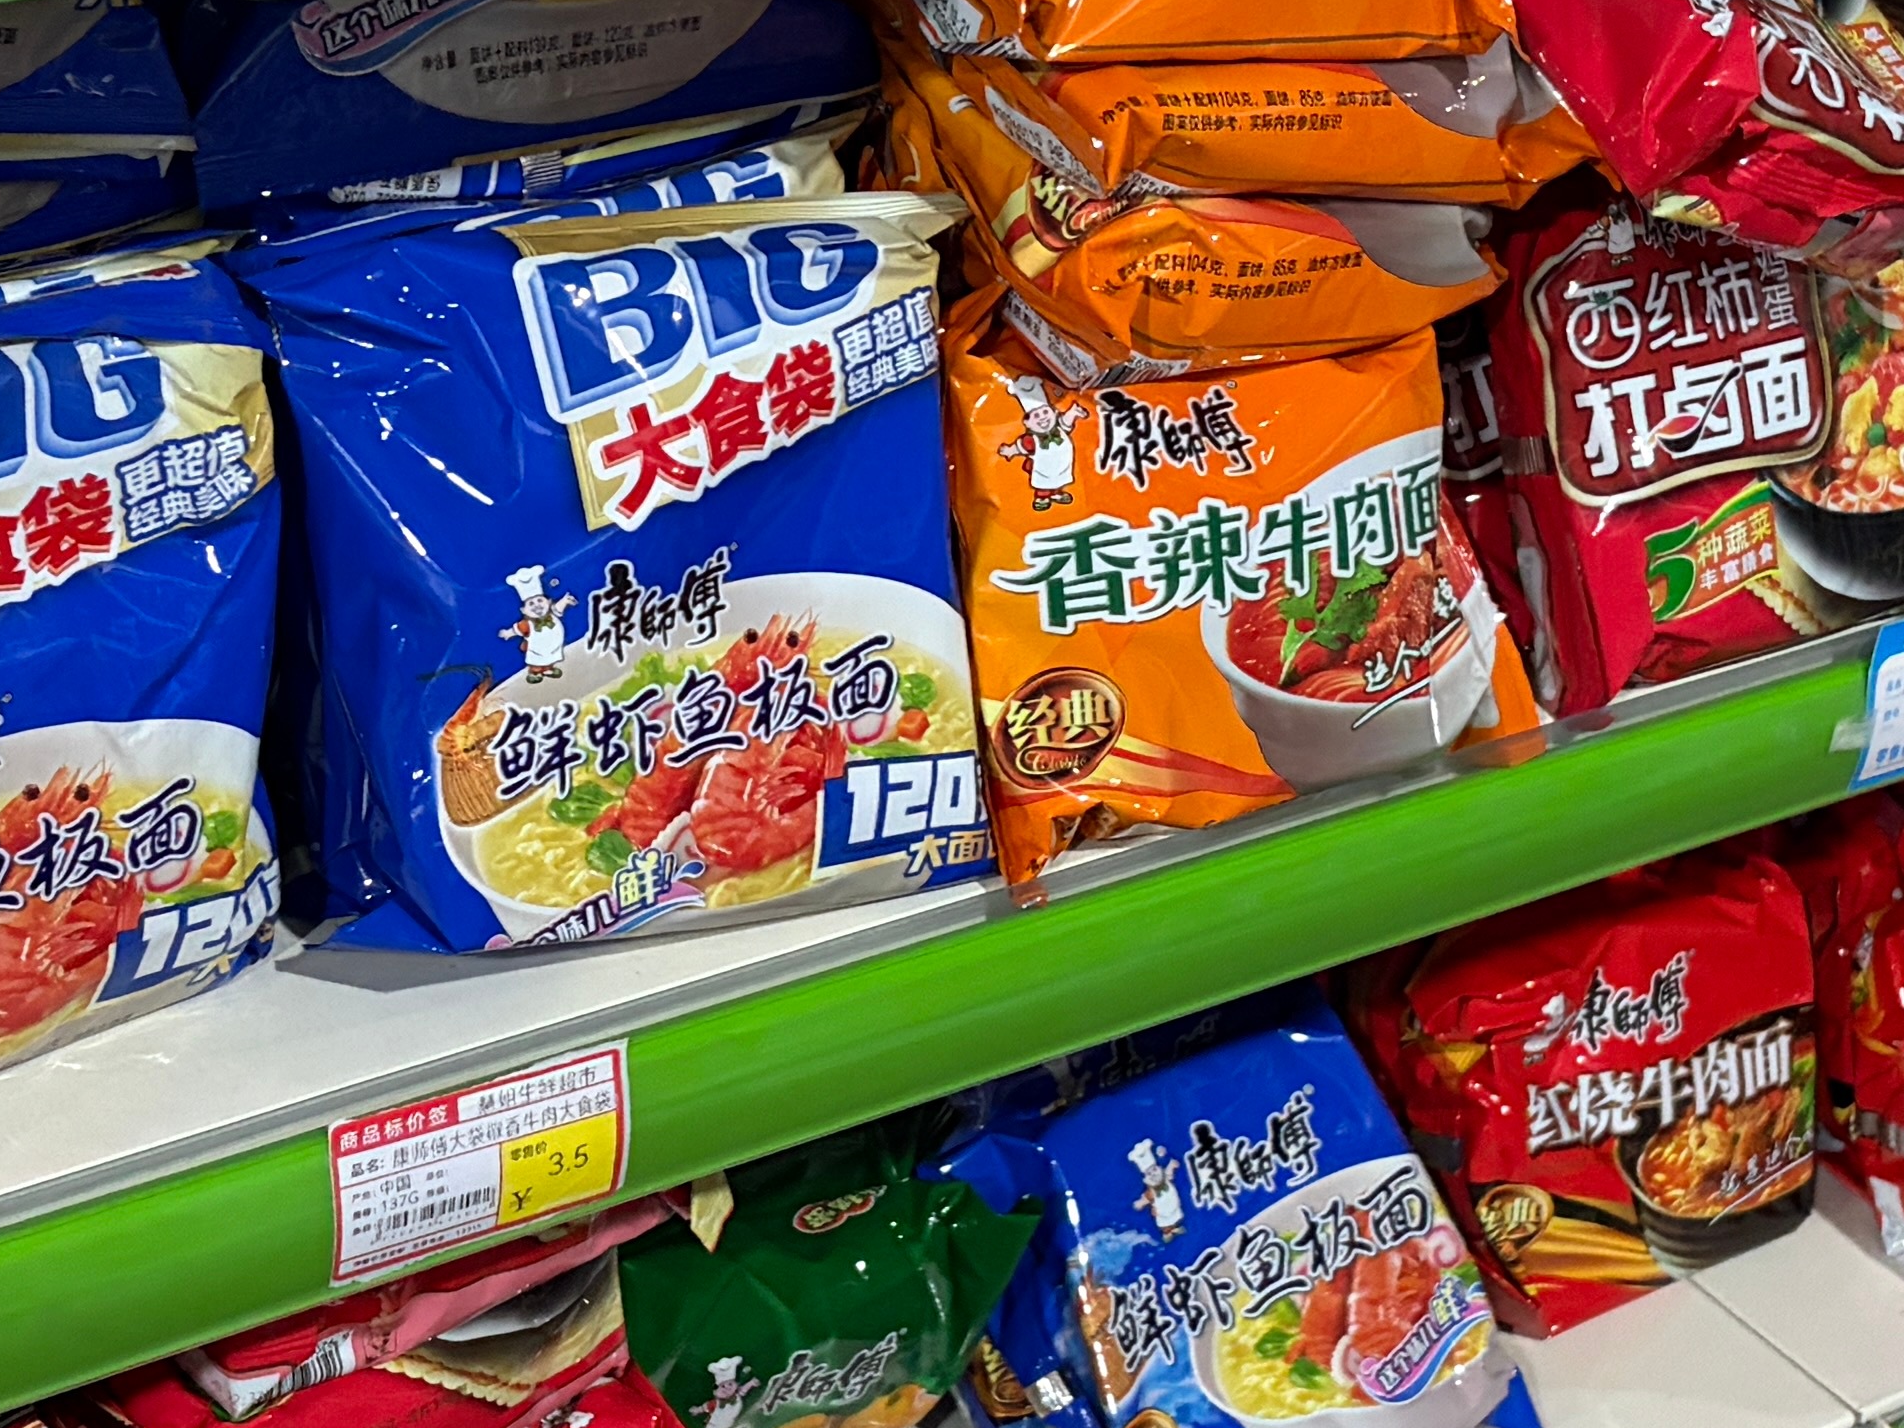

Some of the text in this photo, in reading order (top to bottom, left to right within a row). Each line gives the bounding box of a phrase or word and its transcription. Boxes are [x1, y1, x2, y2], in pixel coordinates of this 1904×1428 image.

[530, 220, 882, 410] BIG
[836, 287, 936, 366] 更超值
[1564, 257, 1759, 371] 西红柿
[1752, 246, 1799, 333] 鸡蛋
[118, 424, 248, 504] 更超值
[601, 343, 838, 522] 大食袋
[1096, 385, 1256, 490] 康師傅
[1574, 336, 1814, 480] 打卤面
[991, 452, 1444, 634] 香辣牛肉面
[586, 556, 733, 662] 康師傅
[491, 632, 899, 798] 鲜虾鱼板面
[339, 1103, 450, 1153] 商品标价签
[1525, 1017, 1794, 1156] 红烧牛肉面
[509, 1186, 533, 1213] ¥
[547, 1143, 590, 1177] 3.5
[1190, 1090, 1321, 1214] 康師傅
[1110, 1161, 1435, 1373] 鲜虾鱼板面
